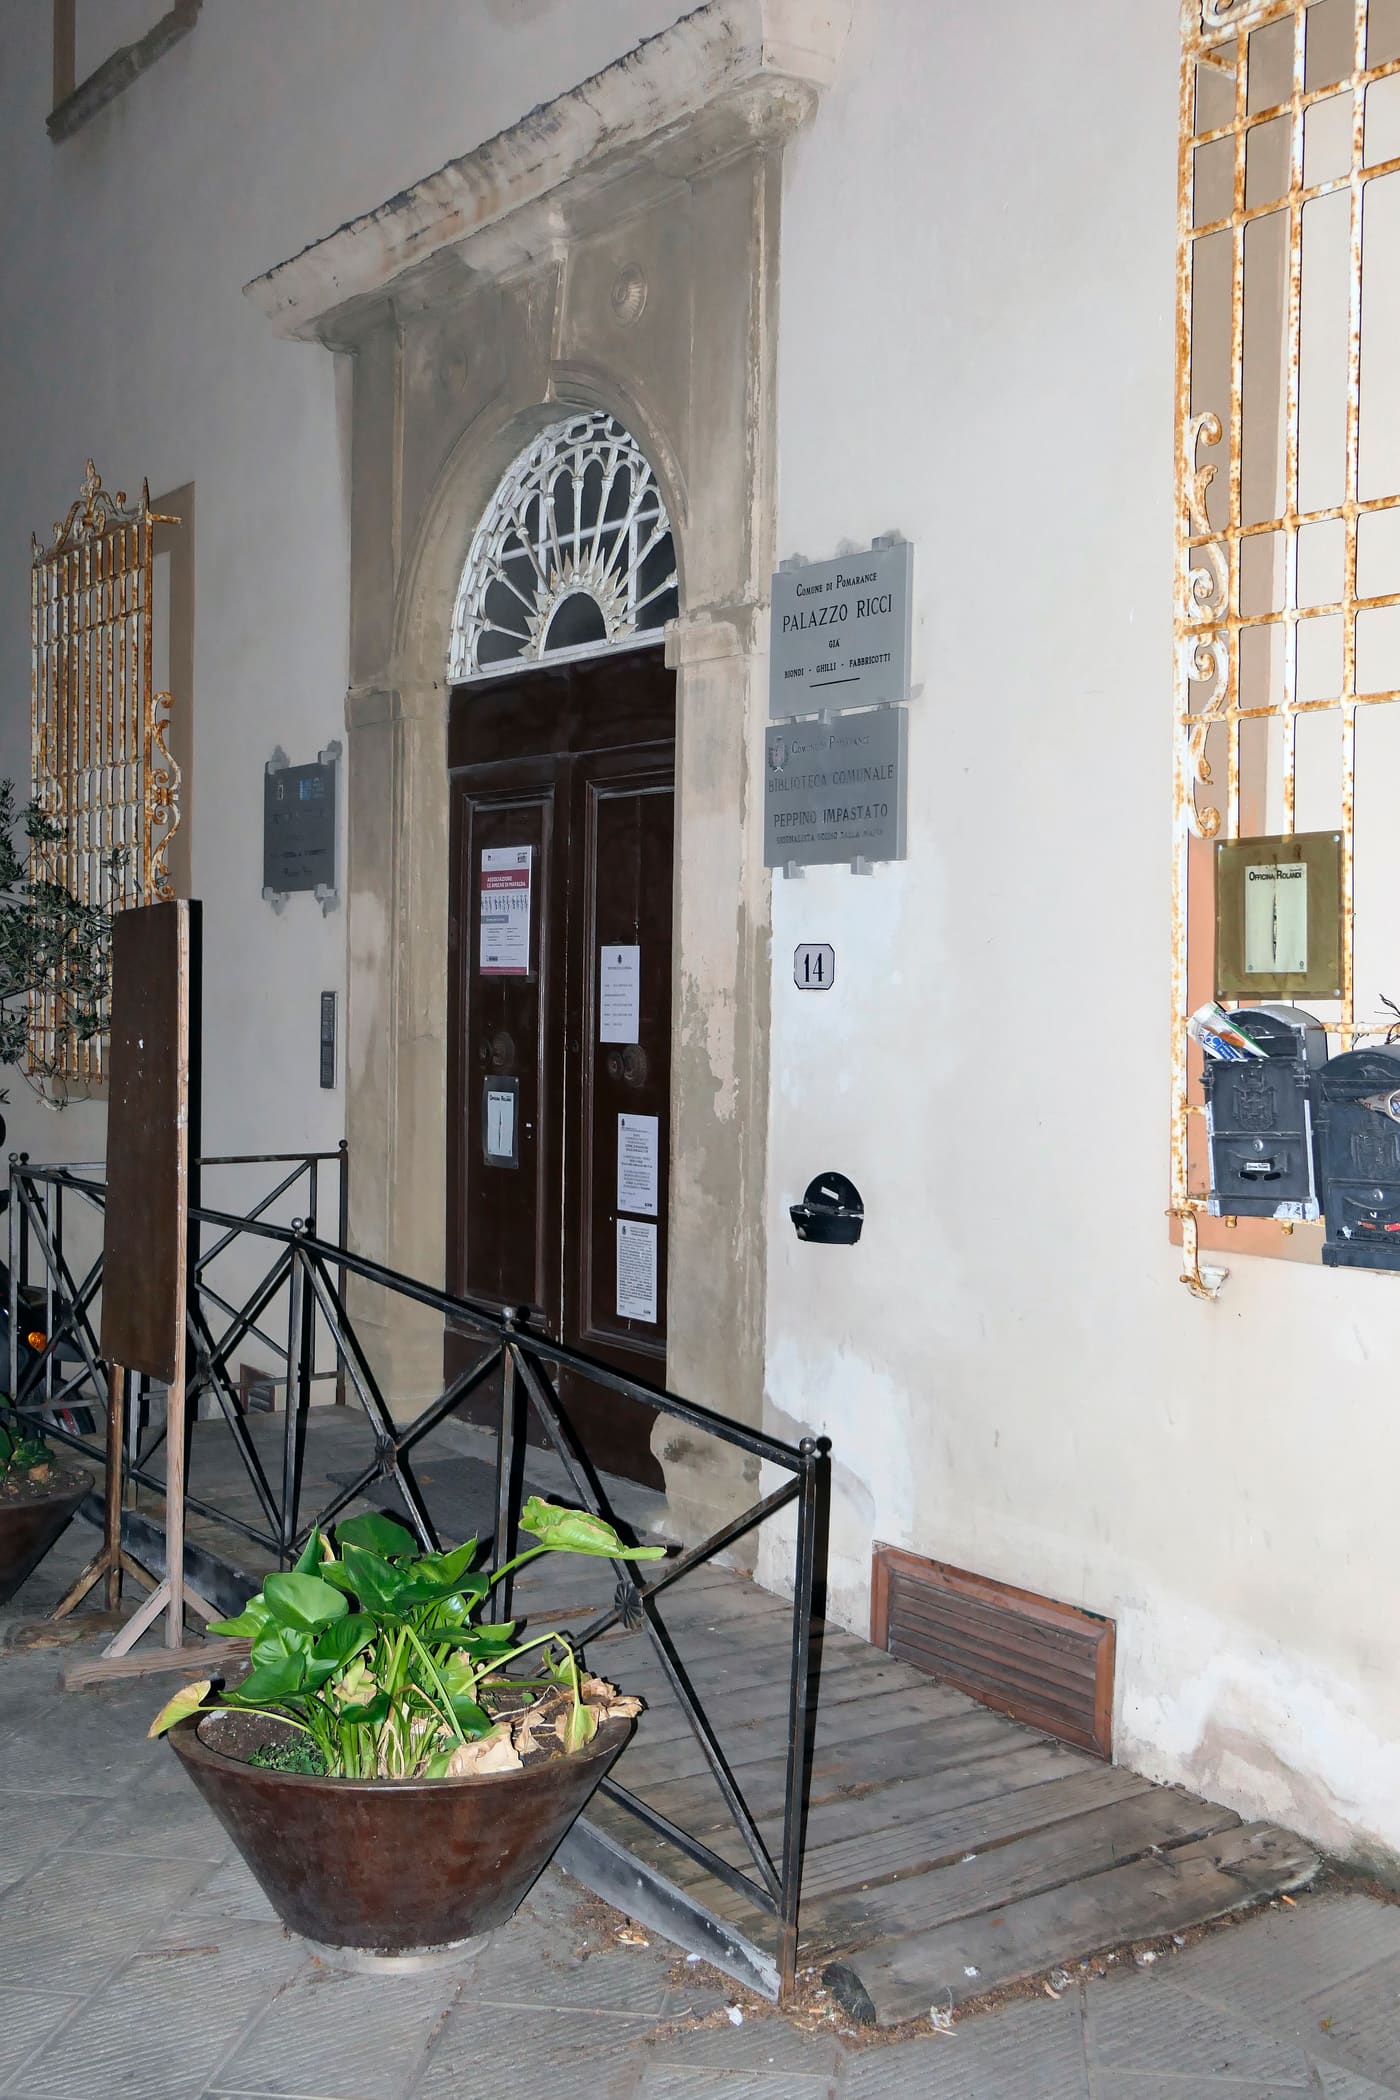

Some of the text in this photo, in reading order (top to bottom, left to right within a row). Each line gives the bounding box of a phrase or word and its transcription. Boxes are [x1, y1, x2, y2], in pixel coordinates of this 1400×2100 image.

[782, 594, 893, 633] PALAZZO RICCI
[784, 667, 805, 679] BIONDI
[815, 662, 837, 673] GHILLI
[849, 652, 891, 668] FABBRICOTTI
[768, 764, 895, 793] BIBLIOTECA COMUNALE
[773, 803, 889, 828] PEPPINO IMPASTATO
[1248, 870, 1302, 881] OFFICINA ROLANDI
[803, 952, 825, 983] 14
